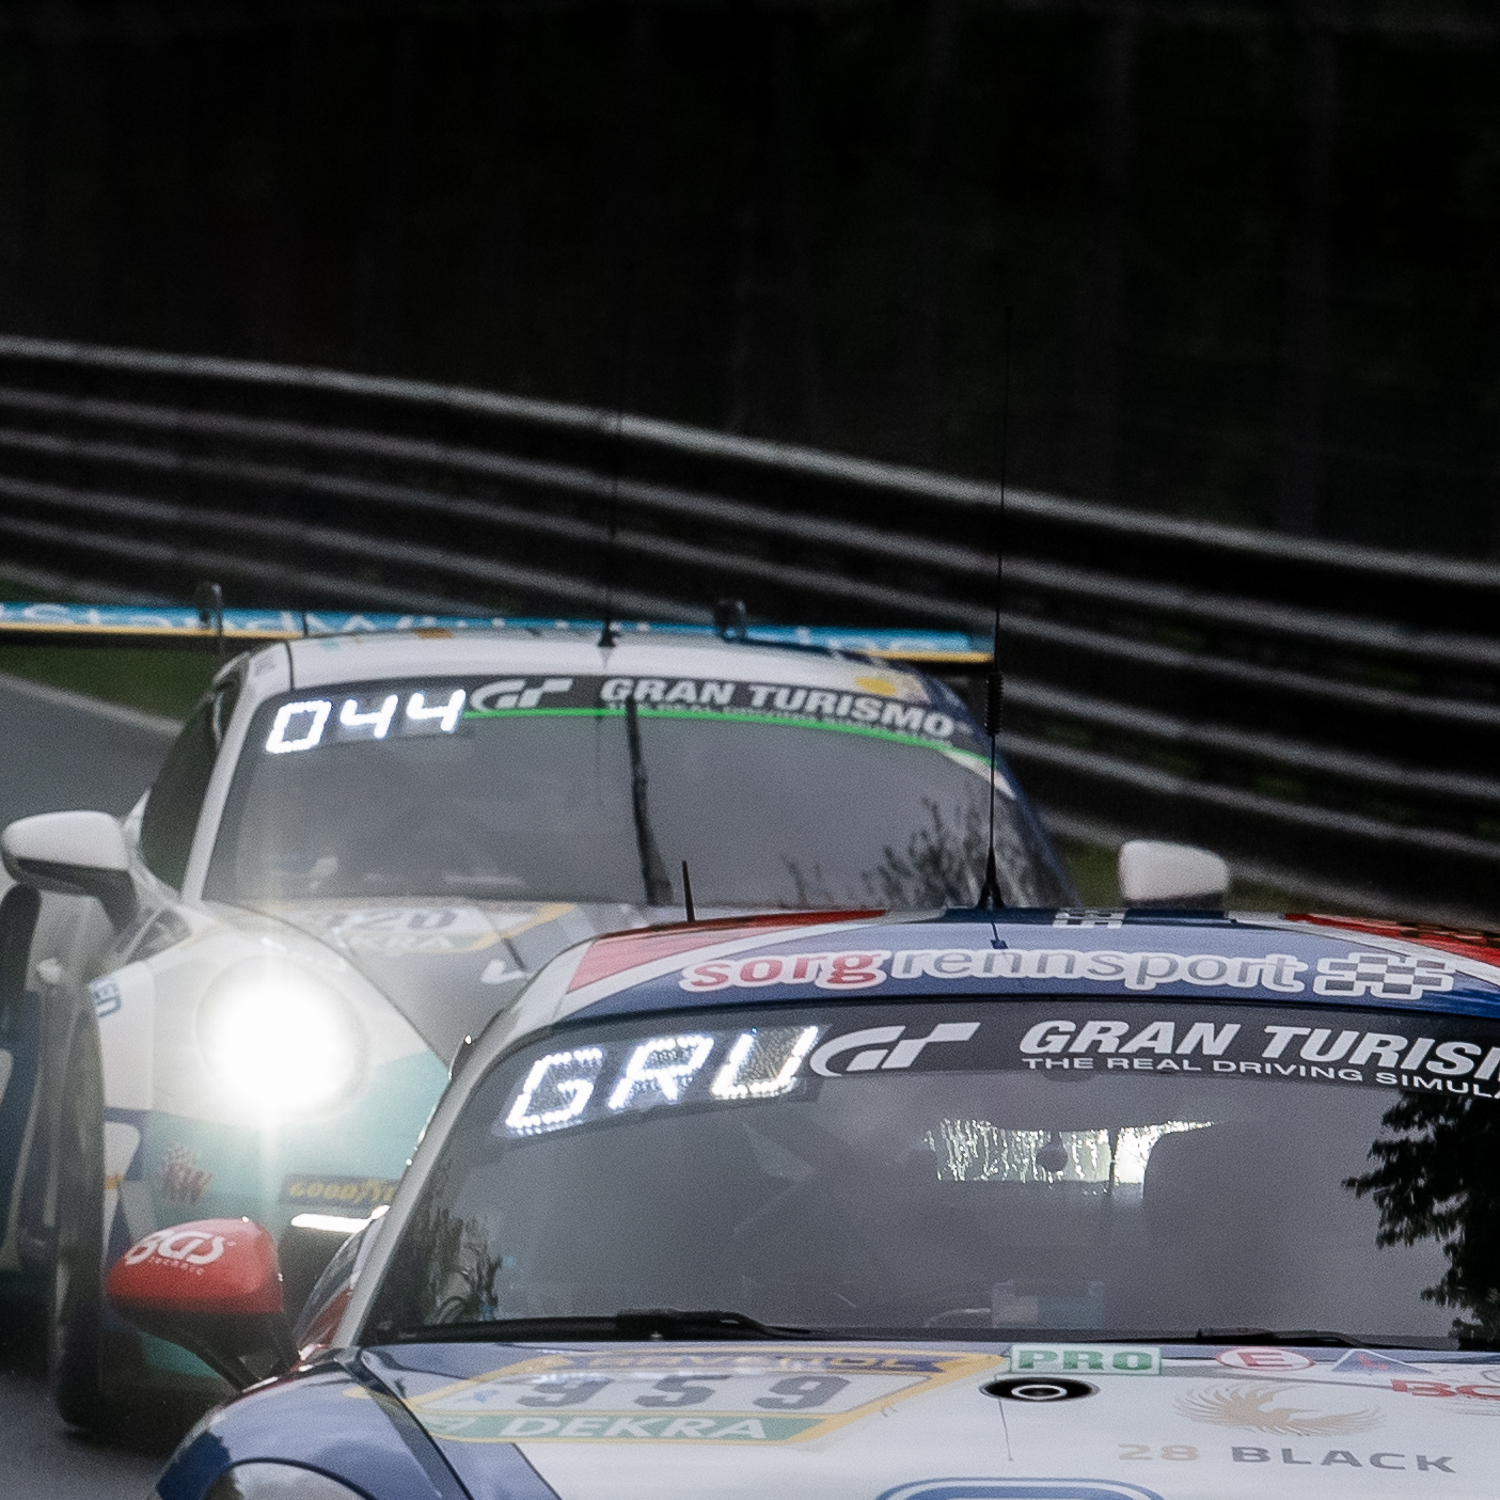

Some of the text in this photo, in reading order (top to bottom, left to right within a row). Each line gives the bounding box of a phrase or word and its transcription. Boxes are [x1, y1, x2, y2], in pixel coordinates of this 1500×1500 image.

[600, 678, 737, 705] GRAN
[264, 688, 467, 754] 044
[1019, 1020, 1243, 1058] GRAN
[503, 1025, 820, 1136] GRU
[1021, 1057, 1094, 1070] THE
[1106, 1057, 1202, 1072] REAL
[1212, 1059, 1363, 1082] DRIVING
[1017, 1350, 1155, 1371] PRO
[514, 1375, 852, 1410] 959
[500, 1416, 769, 1440] DEKRA
[1116, 1443, 1457, 1474] 28 BLACK
